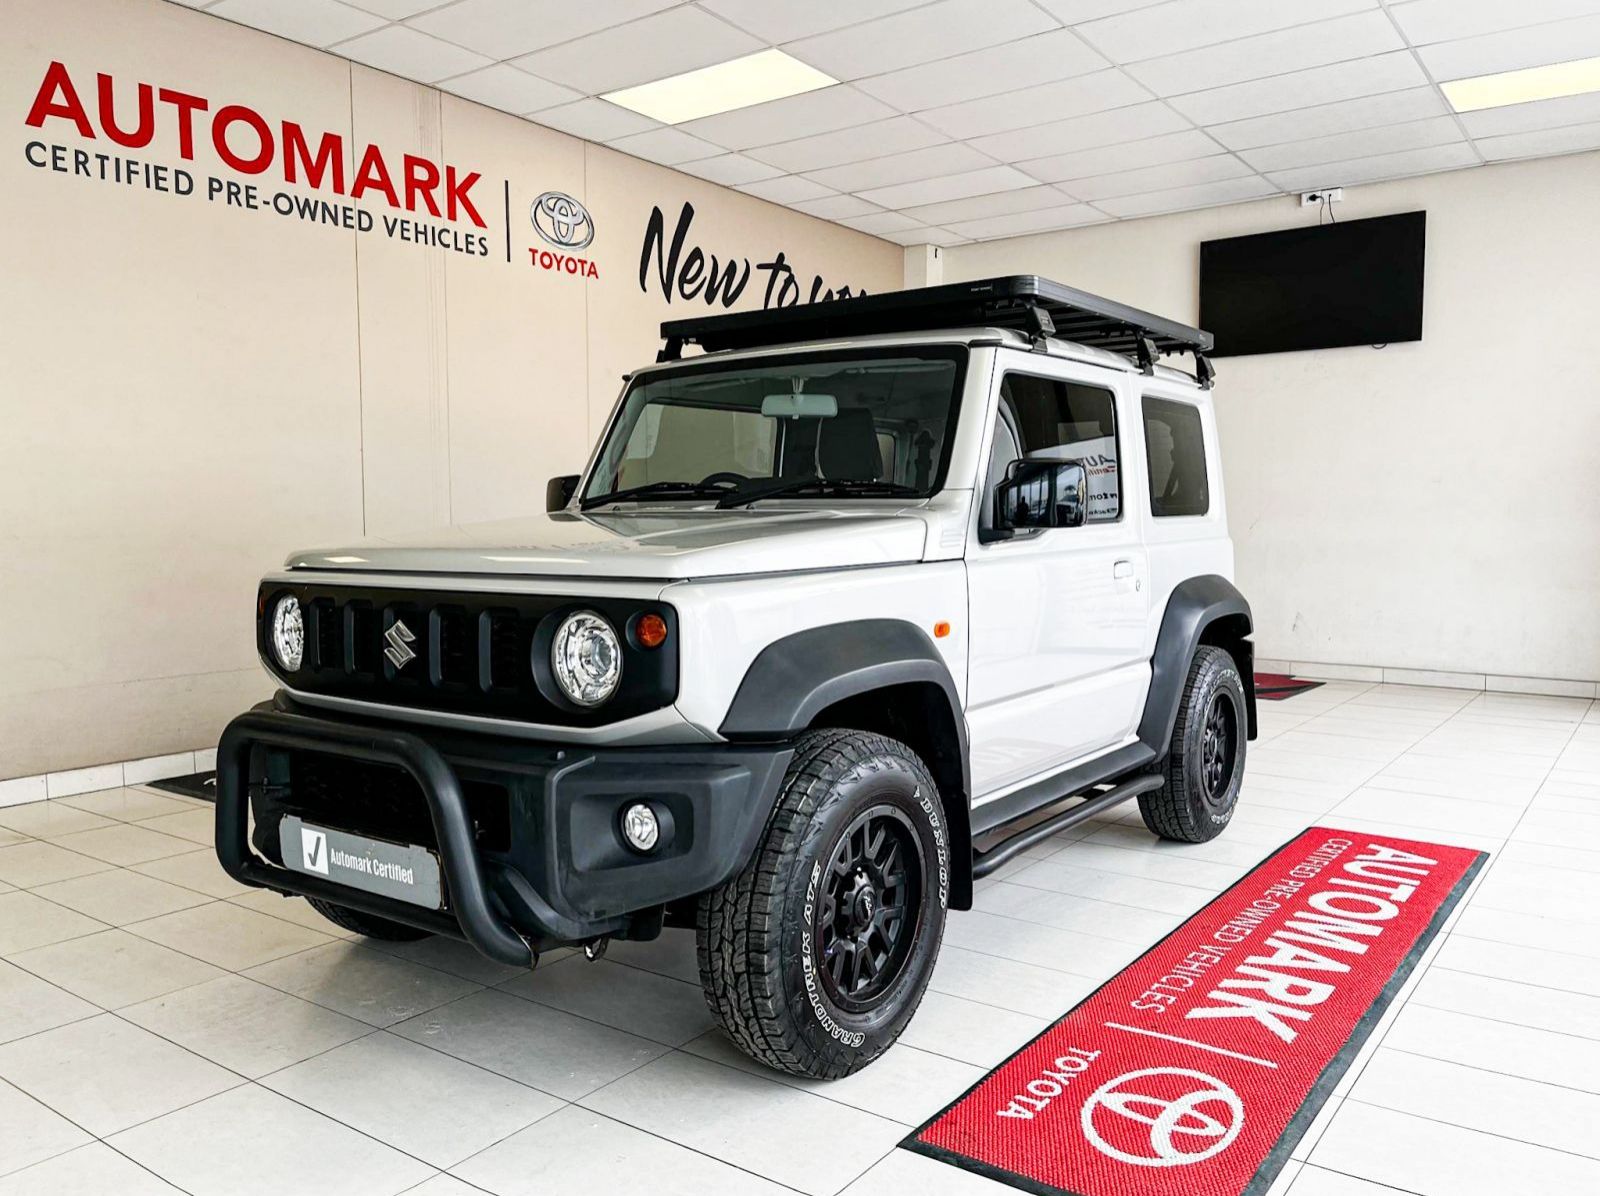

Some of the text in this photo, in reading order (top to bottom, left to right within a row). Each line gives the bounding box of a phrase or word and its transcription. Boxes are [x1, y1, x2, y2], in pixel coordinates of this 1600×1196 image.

[25, 141, 488, 257] CERTIFIED PRE-OWNED VEHICLES
[26, 61, 487, 230] AUTOMARK
[529, 247, 599, 279] TOYOTA
[639, 201, 750, 308] New
[330, 847, 414, 885] Automark Certified
[920, 797, 948, 909] DUNLOP
[1130, 838, 1353, 1014] CERTIFIED PRE-OWNED VEHICLES
[1184, 843, 1439, 1045] AUTOMARK
[802, 931, 866, 1048] GRANDTREK
[996, 1046, 1102, 1121] TOYOTA
